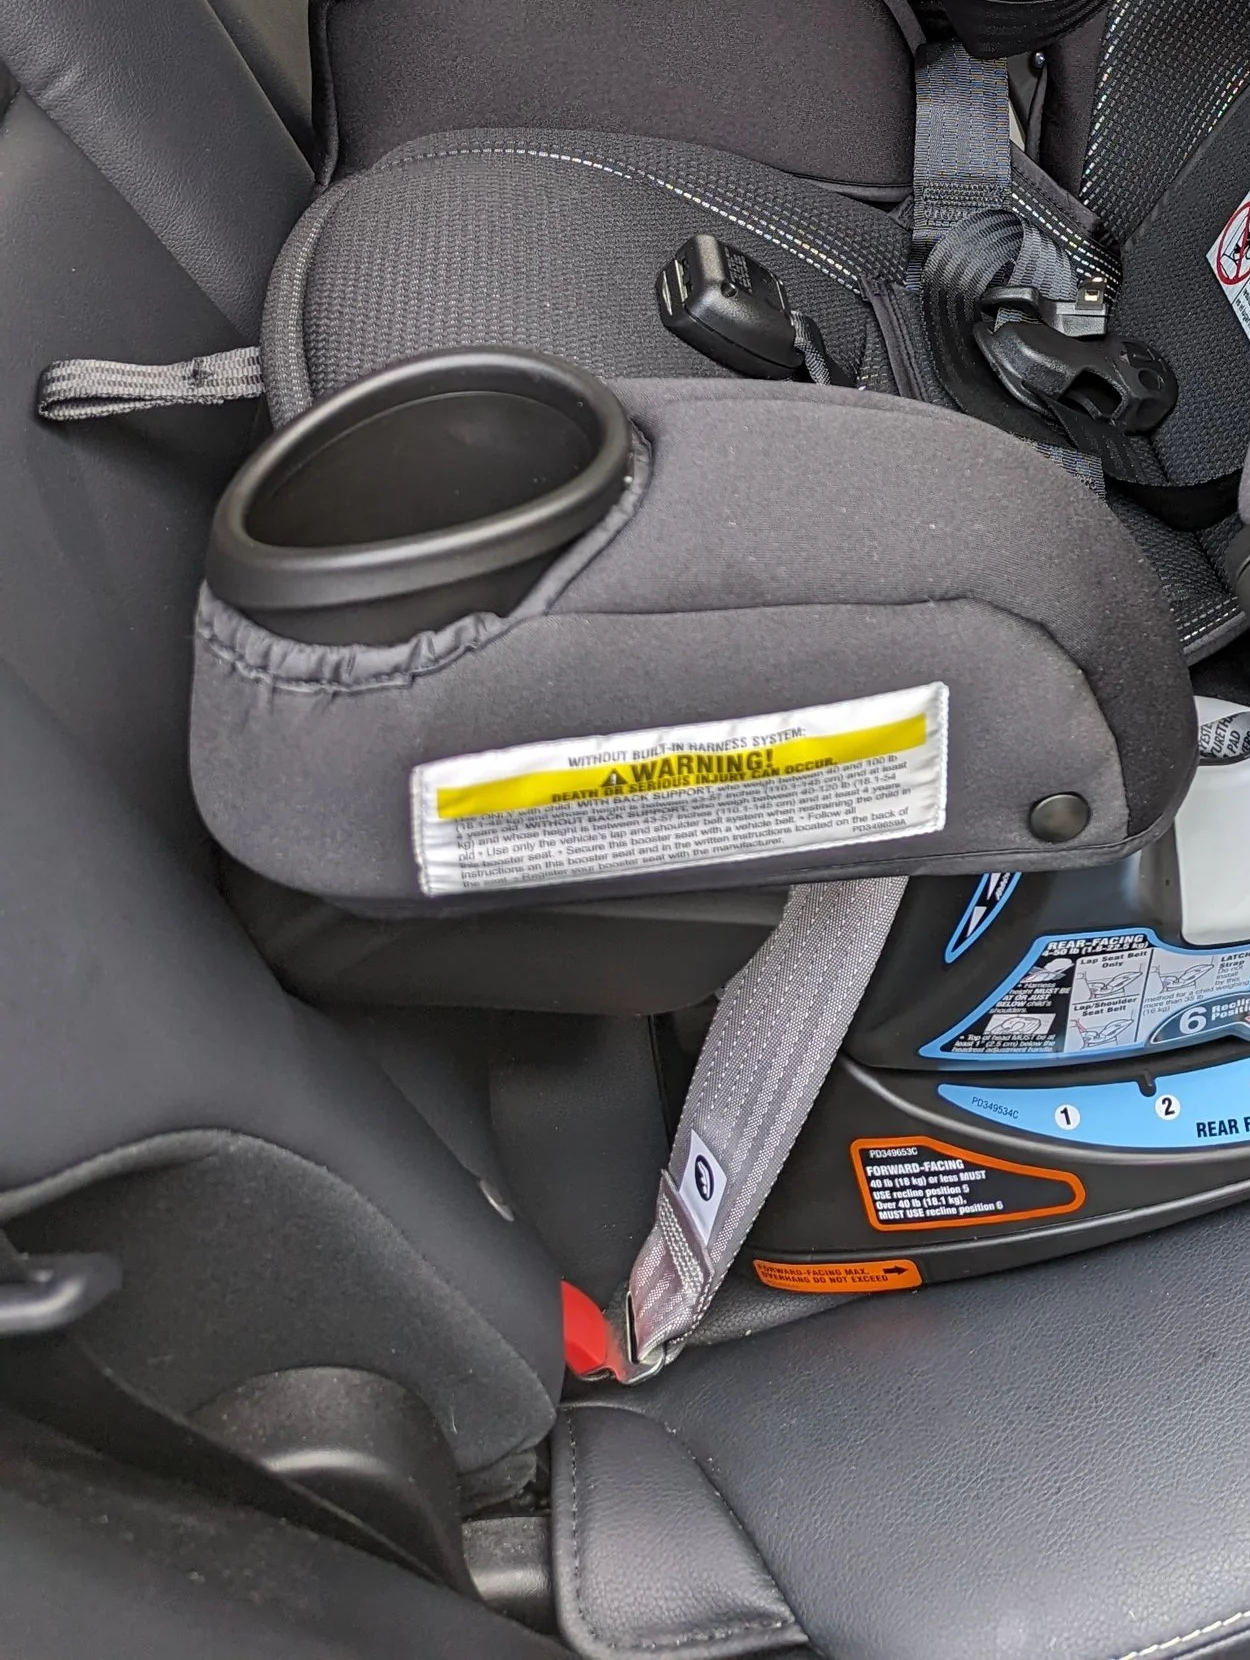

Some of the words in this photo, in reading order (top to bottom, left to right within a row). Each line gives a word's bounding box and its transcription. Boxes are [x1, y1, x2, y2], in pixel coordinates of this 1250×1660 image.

[568, 749, 628, 768] WITHOUT
[633, 742, 684, 760] BUILT-IN
[690, 738, 748, 753] HARNESS
[752, 726, 806, 748] SYSTEM:
[630, 748, 775, 783] WARNING!
[552, 788, 598, 803] DEATH
[604, 785, 624, 798] OR
[630, 775, 692, 792] SERIOUS
[696, 771, 748, 785] INJURY
[752, 768, 780, 778] CAN
[786, 756, 838, 774] OCCUR.
[1048, 934, 1144, 950] REAR-FACING
[1102, 954, 1124, 962] Seat
[1220, 960, 1245, 968] Strap
[1074, 997, 1137, 1011] Lap/Shoulder
[1082, 1008, 1104, 1017] Seat
[1107, 1005, 1126, 1013] Belt
[1180, 1006, 1208, 1034] 6
[971, 1096, 1019, 1120] PD349534C
[1162, 1098, 1175, 1116] 2
[1060, 1108, 1072, 1125] 1
[1196, 1118, 1239, 1138] REAR
[866, 1159, 965, 1176] FORWARD-FACING
[870, 1180, 882, 1188] 40
[884, 1178, 893, 1187] lb
[895, 1177, 910, 1188] (18
[912, 1176, 927, 1187] kg)
[928, 1176, 938, 1184] or
[940, 1174, 958, 1183] less
[960, 1170, 986, 1181] MUST
[873, 1190, 891, 1200] USE
[893, 1188, 924, 1199] recline
[925, 1184, 961, 1197] position
[962, 1184, 970, 1193] 5
[876, 1201, 896, 1210] Over
[898, 1199, 910, 1208] 40
[912, 1198, 921, 1207] lb
[923, 1197, 947, 1208] (18.1
[879, 1210, 904, 1220] MUST
[906, 1208, 925, 1218] USE
[926, 1206, 957, 1216] recline
[959, 1203, 995, 1215] position
[996, 1200, 1004, 1210] 6
